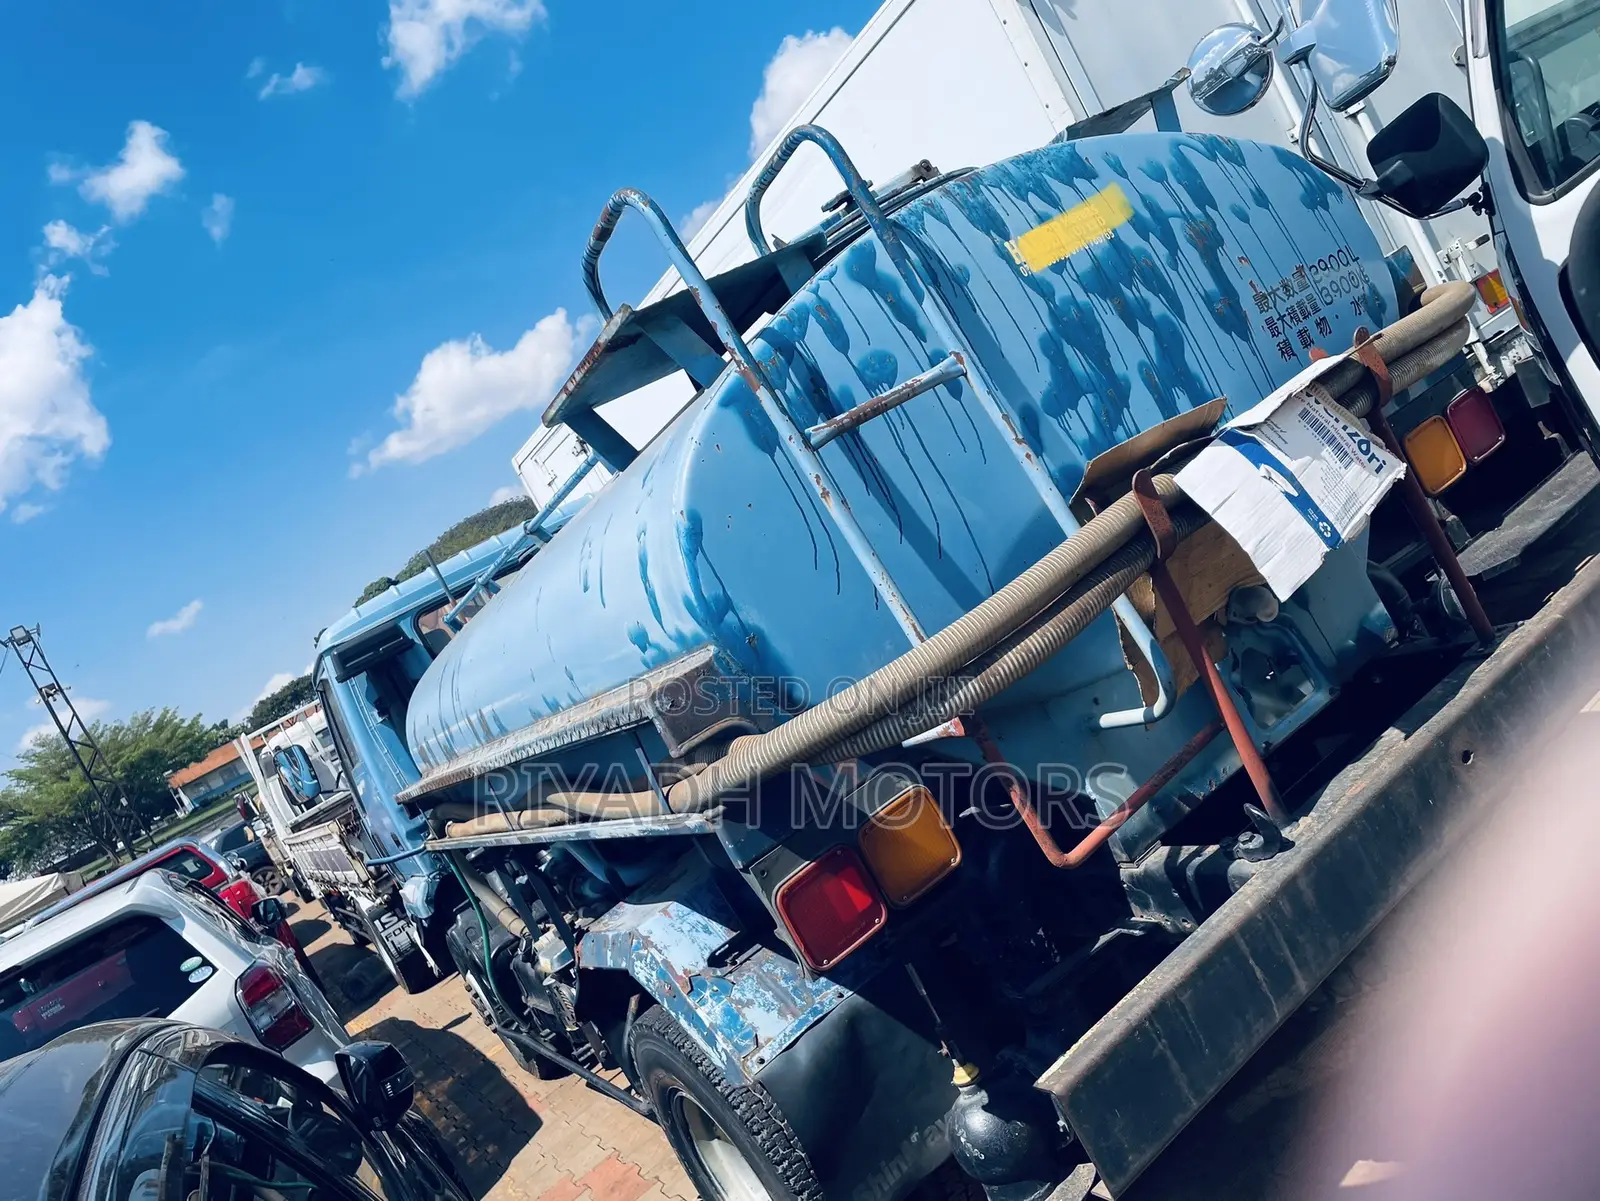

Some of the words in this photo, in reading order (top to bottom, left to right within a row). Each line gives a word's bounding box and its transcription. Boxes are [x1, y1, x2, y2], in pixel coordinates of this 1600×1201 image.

[1306, 402, 1331, 426] Natural
[1330, 424, 1352, 449] Mineral
[1351, 447, 1367, 469] Water
